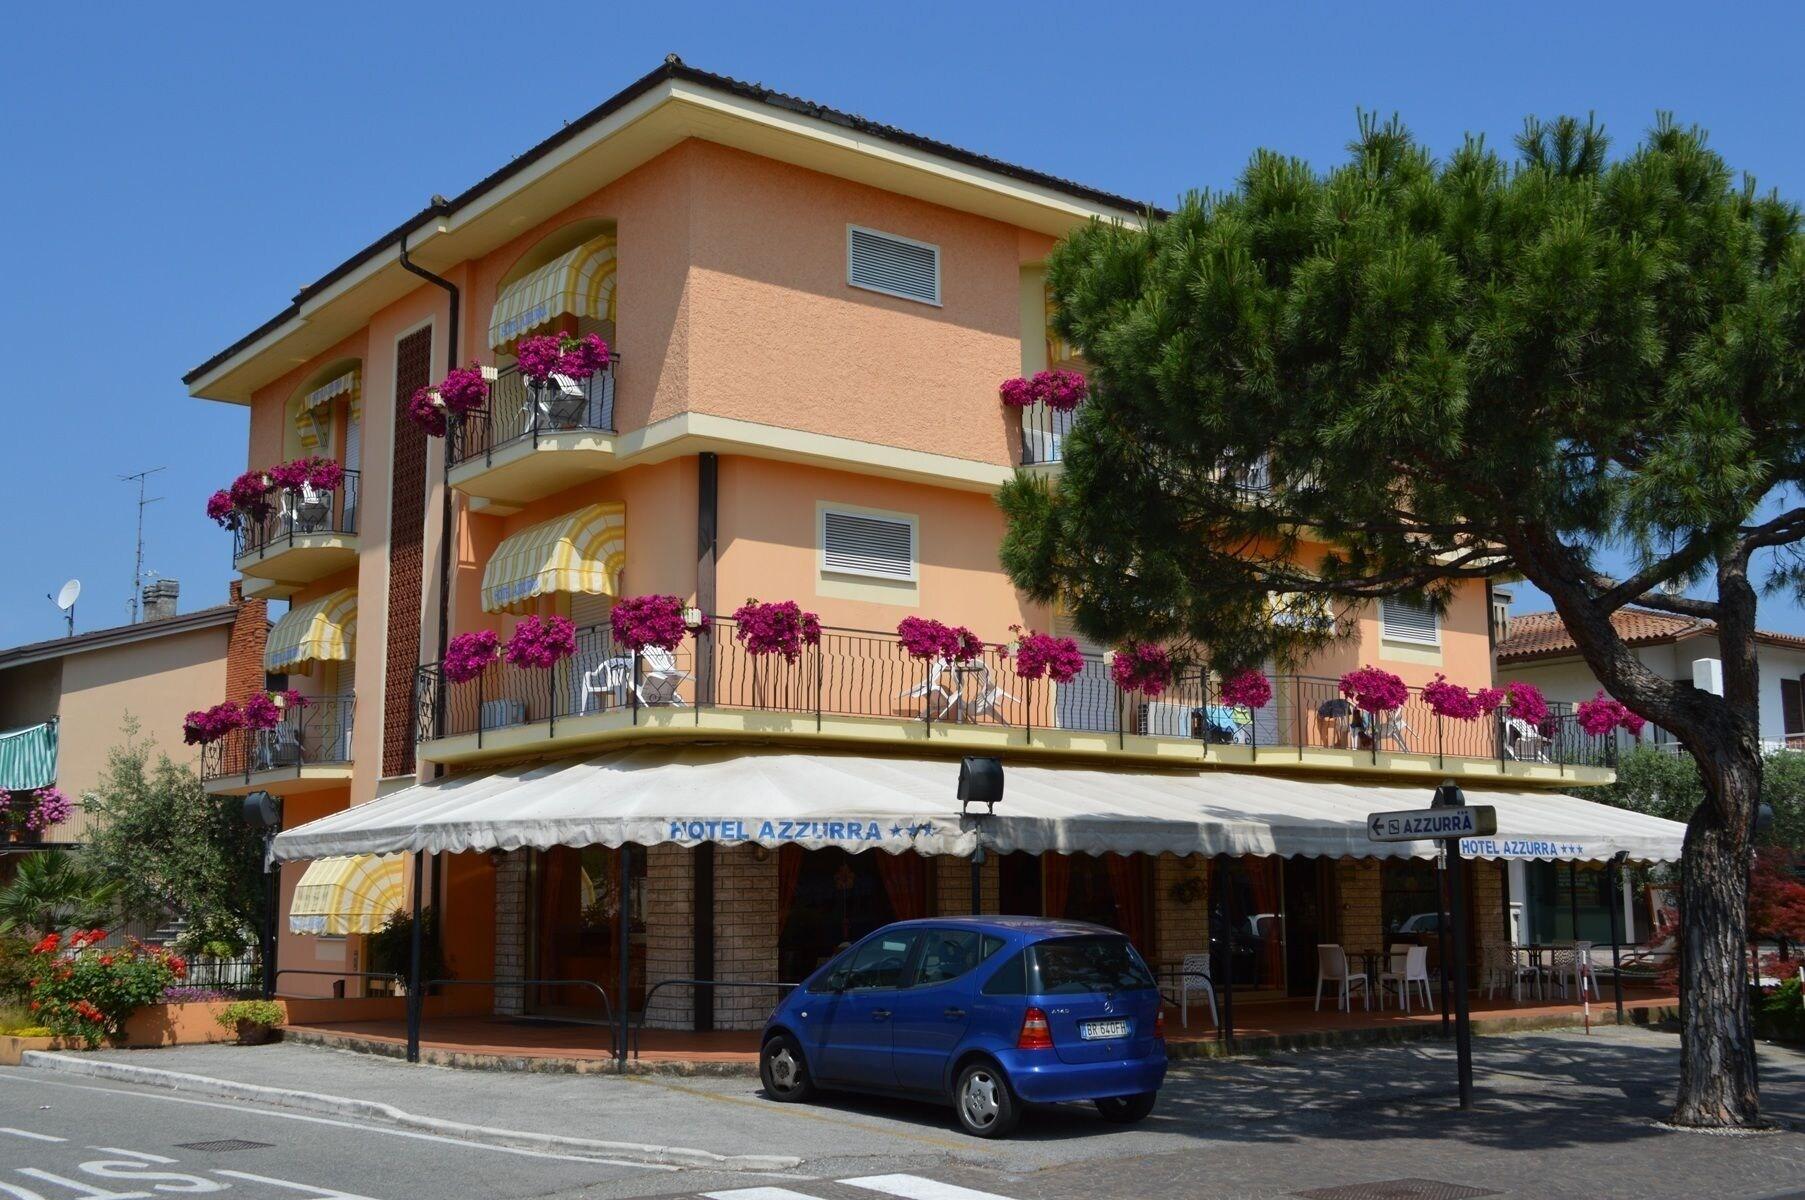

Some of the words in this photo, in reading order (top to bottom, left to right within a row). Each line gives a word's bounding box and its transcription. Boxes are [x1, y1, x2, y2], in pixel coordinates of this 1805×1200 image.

[670, 821, 750, 840] HOTEL
[758, 821, 883, 841] AZZURRA
[1403, 816, 1473, 834] AZZURRA
[1462, 840, 1500, 855] HOTEL
[1503, 840, 1558, 856] AZZURRA
